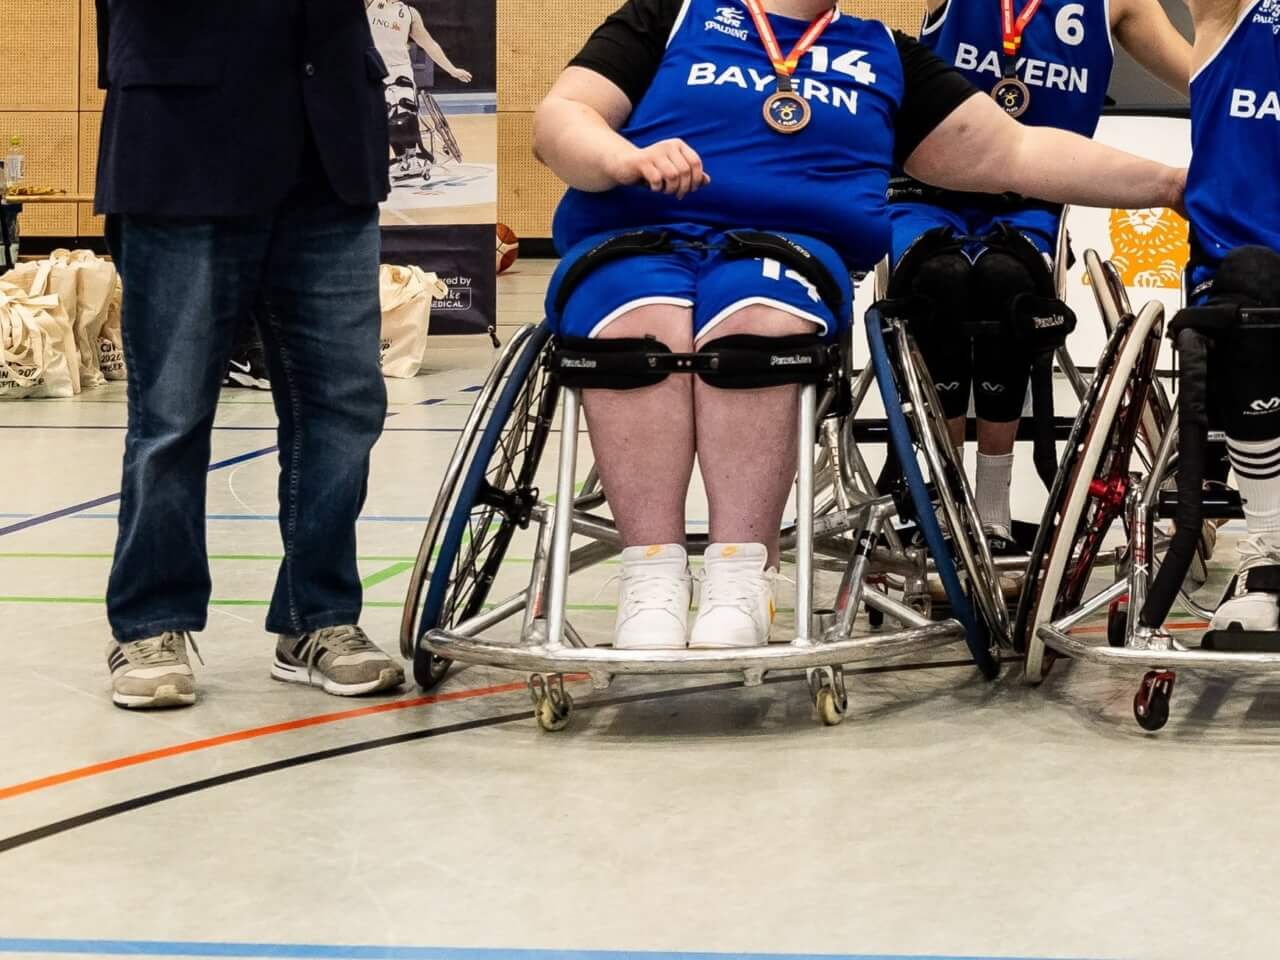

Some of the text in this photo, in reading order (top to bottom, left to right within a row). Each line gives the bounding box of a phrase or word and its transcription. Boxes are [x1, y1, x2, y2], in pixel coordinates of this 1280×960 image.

[372, 17, 391, 29] ING
[1055, 3, 1085, 46] 6
[808, 45, 876, 85] 14
[430, 300, 464, 308] EDICAL
